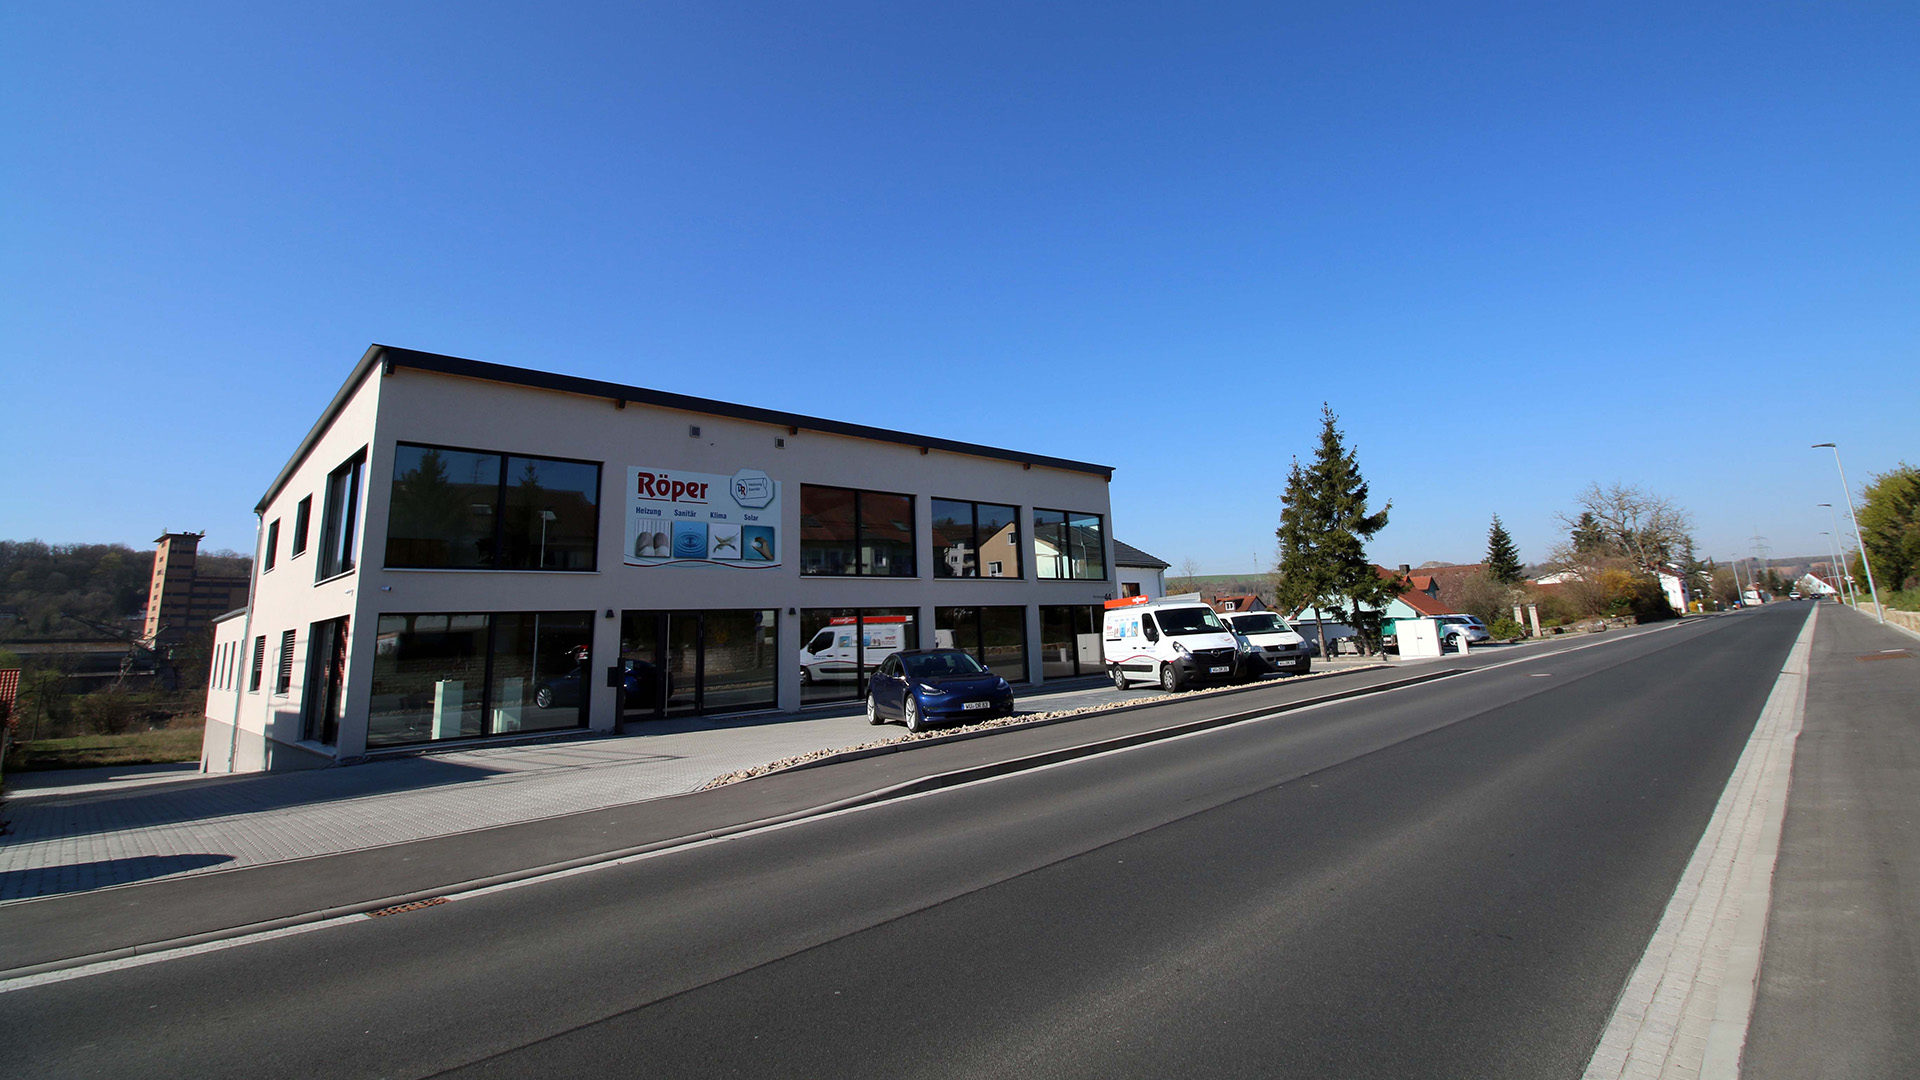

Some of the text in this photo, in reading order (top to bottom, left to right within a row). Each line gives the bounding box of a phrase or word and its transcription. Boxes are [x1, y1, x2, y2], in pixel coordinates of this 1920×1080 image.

[637, 472, 709, 502] Röper
[636, 506, 759, 521] Heizung Sanitär Klima Solar
